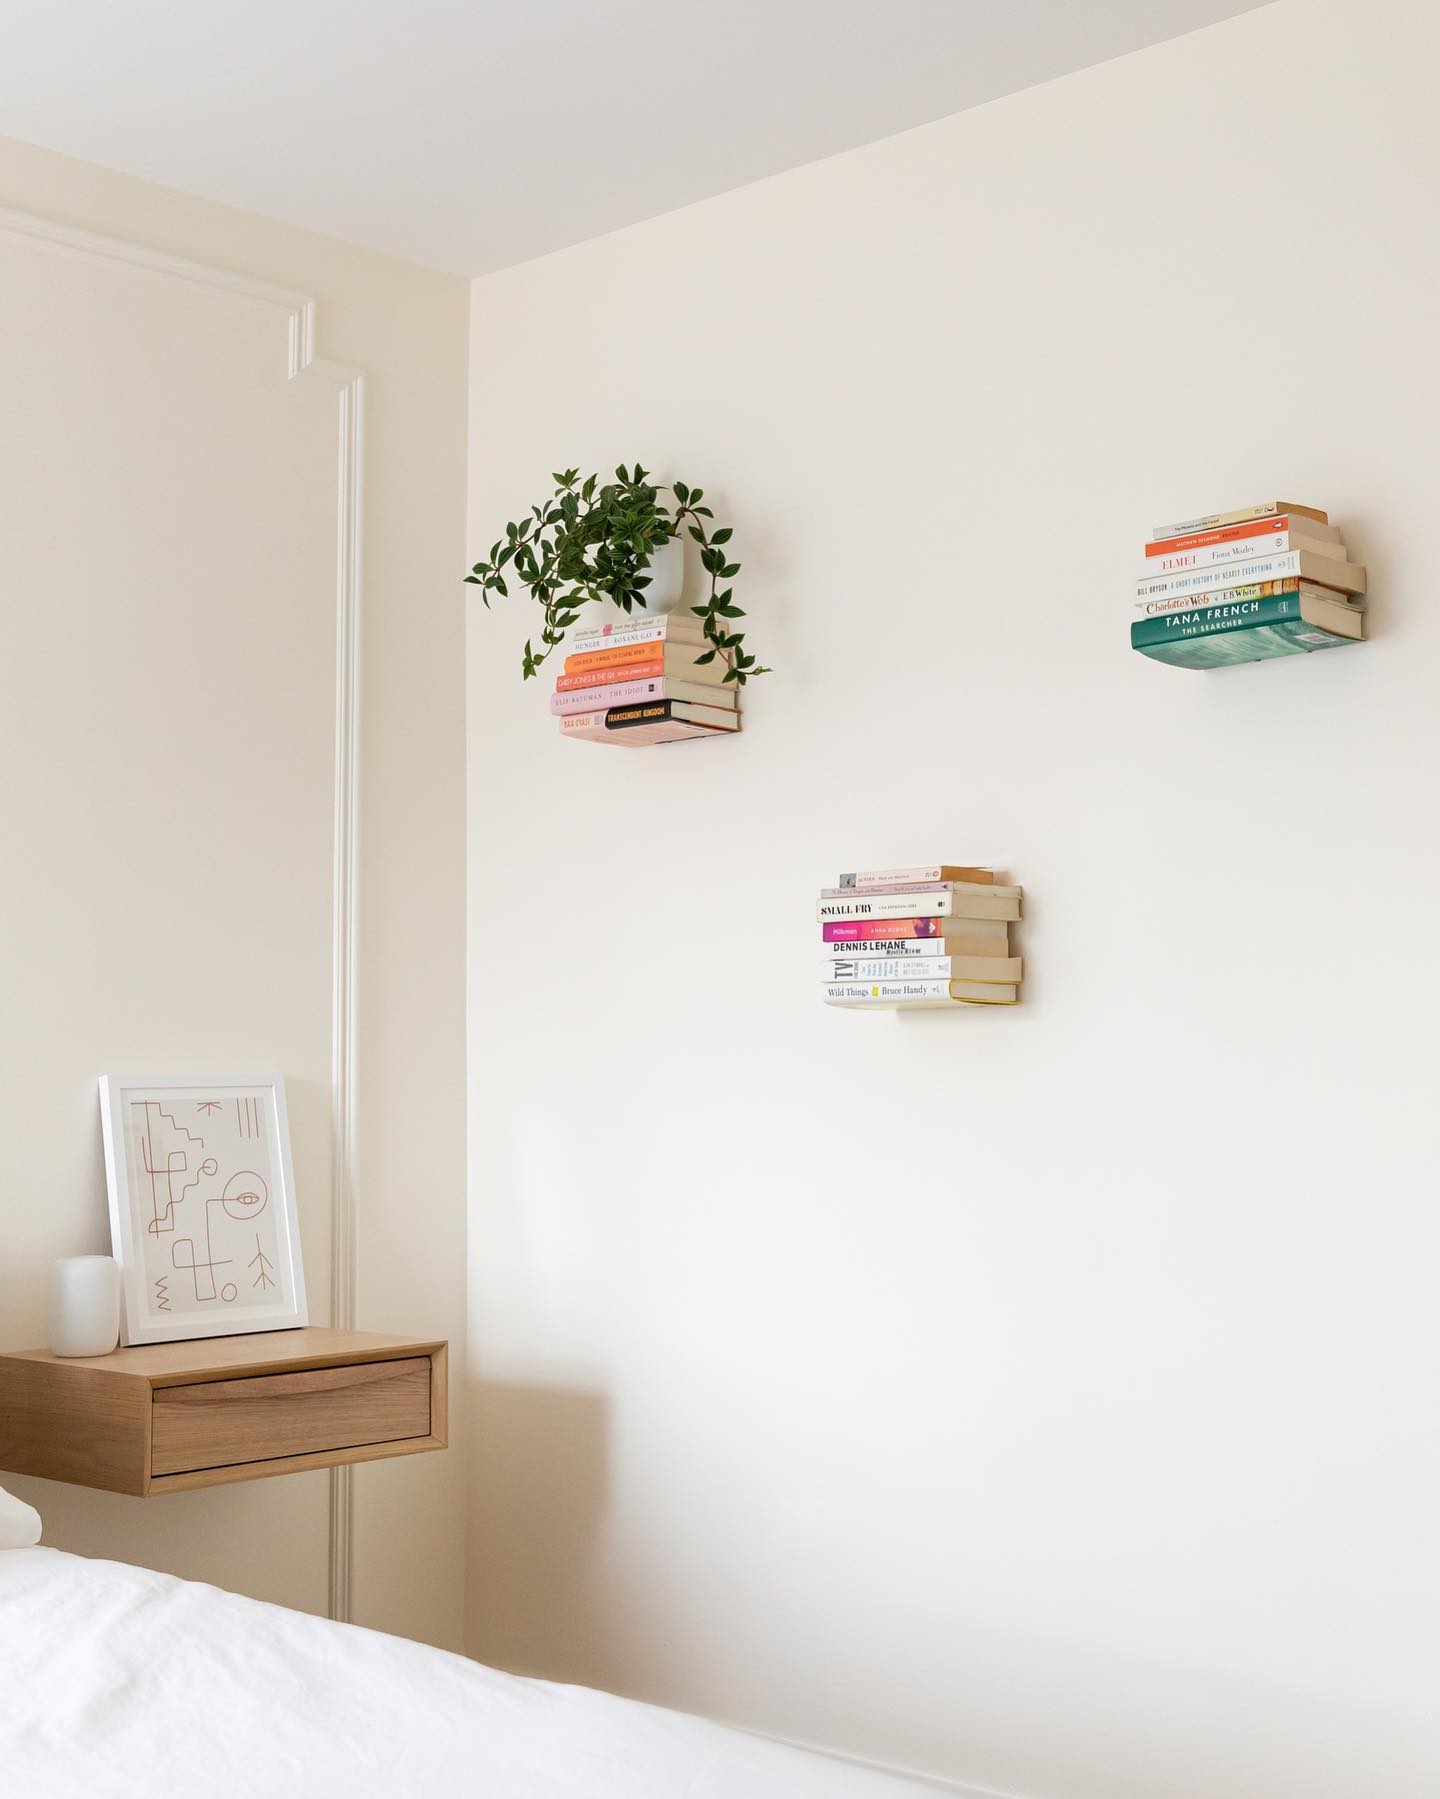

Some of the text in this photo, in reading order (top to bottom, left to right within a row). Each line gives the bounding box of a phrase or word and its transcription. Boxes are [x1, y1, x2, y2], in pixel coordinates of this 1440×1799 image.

[1162, 545, 1256, 570] ELMET Fiona Mozley
[1137, 588, 1148, 596] BILL
[1149, 584, 1168, 594] BRYSON
[1176, 578, 1191, 588] SHORT
[1192, 575, 1214, 586] HISTORY
[1214, 573, 1221, 582] OF
[1222, 569, 1241, 580] NEARLY
[1242, 563, 1273, 576] EVERYTHING
[1146, 599, 1190, 615] Charlotte's
[1190, 594, 1210, 607] Web
[1165, 602, 1260, 628] TANA FRENCH
[1182, 619, 1243, 636] THE SEARCHER
[575, 632, 654, 650] HUNGER ROXANE GAY
[572, 694, 602, 703] BATUMAN
[610, 689, 622, 698] THE
[624, 686, 644, 697] IDIOT
[607, 710, 642, 722] TRANSCENDENT
[643, 706, 665, 718] KINGDOM
[821, 903, 873, 916] SMALL FRY
[832, 928, 858, 936] Milkman
[833, 940, 906, 952] DENNIS LEHANE
[834, 962, 853, 979] TV
[828, 985, 928, 998] Wild Things Bruce Handy
